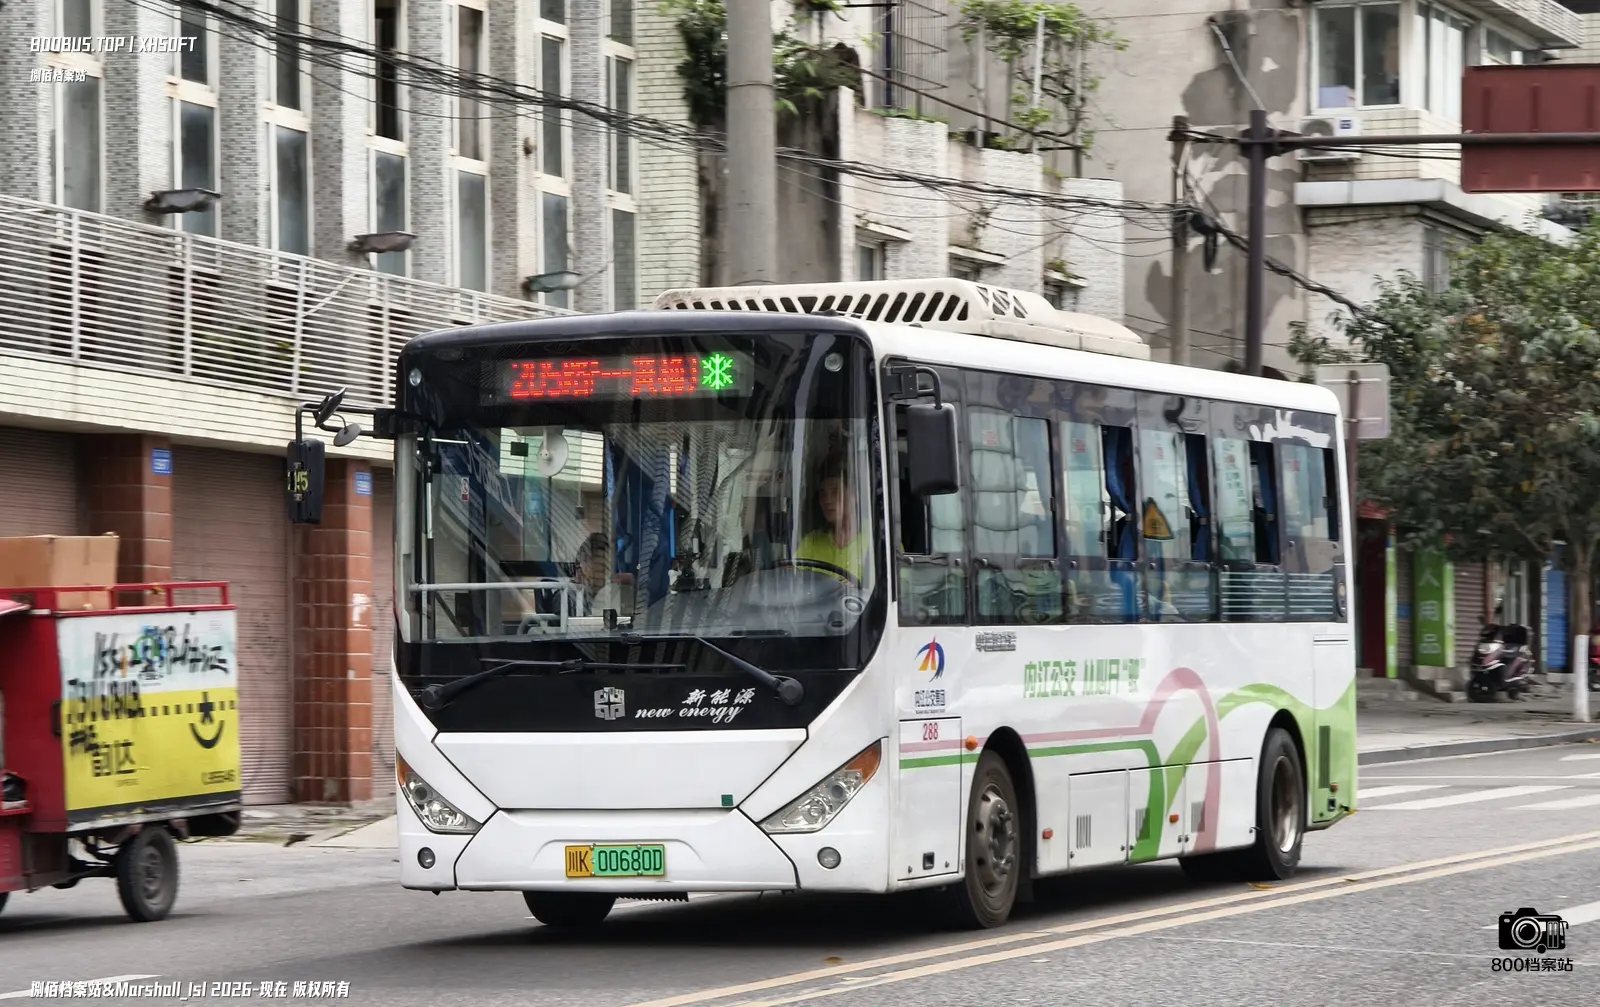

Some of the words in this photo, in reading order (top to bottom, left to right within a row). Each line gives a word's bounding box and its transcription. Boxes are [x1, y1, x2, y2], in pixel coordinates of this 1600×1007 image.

[1023, 660, 1076, 698] 内江公交
[682, 688, 755, 706] 新能源
[635, 707, 675, 718] new
[679, 706, 743, 724] energy
[923, 722, 939, 740] 288
